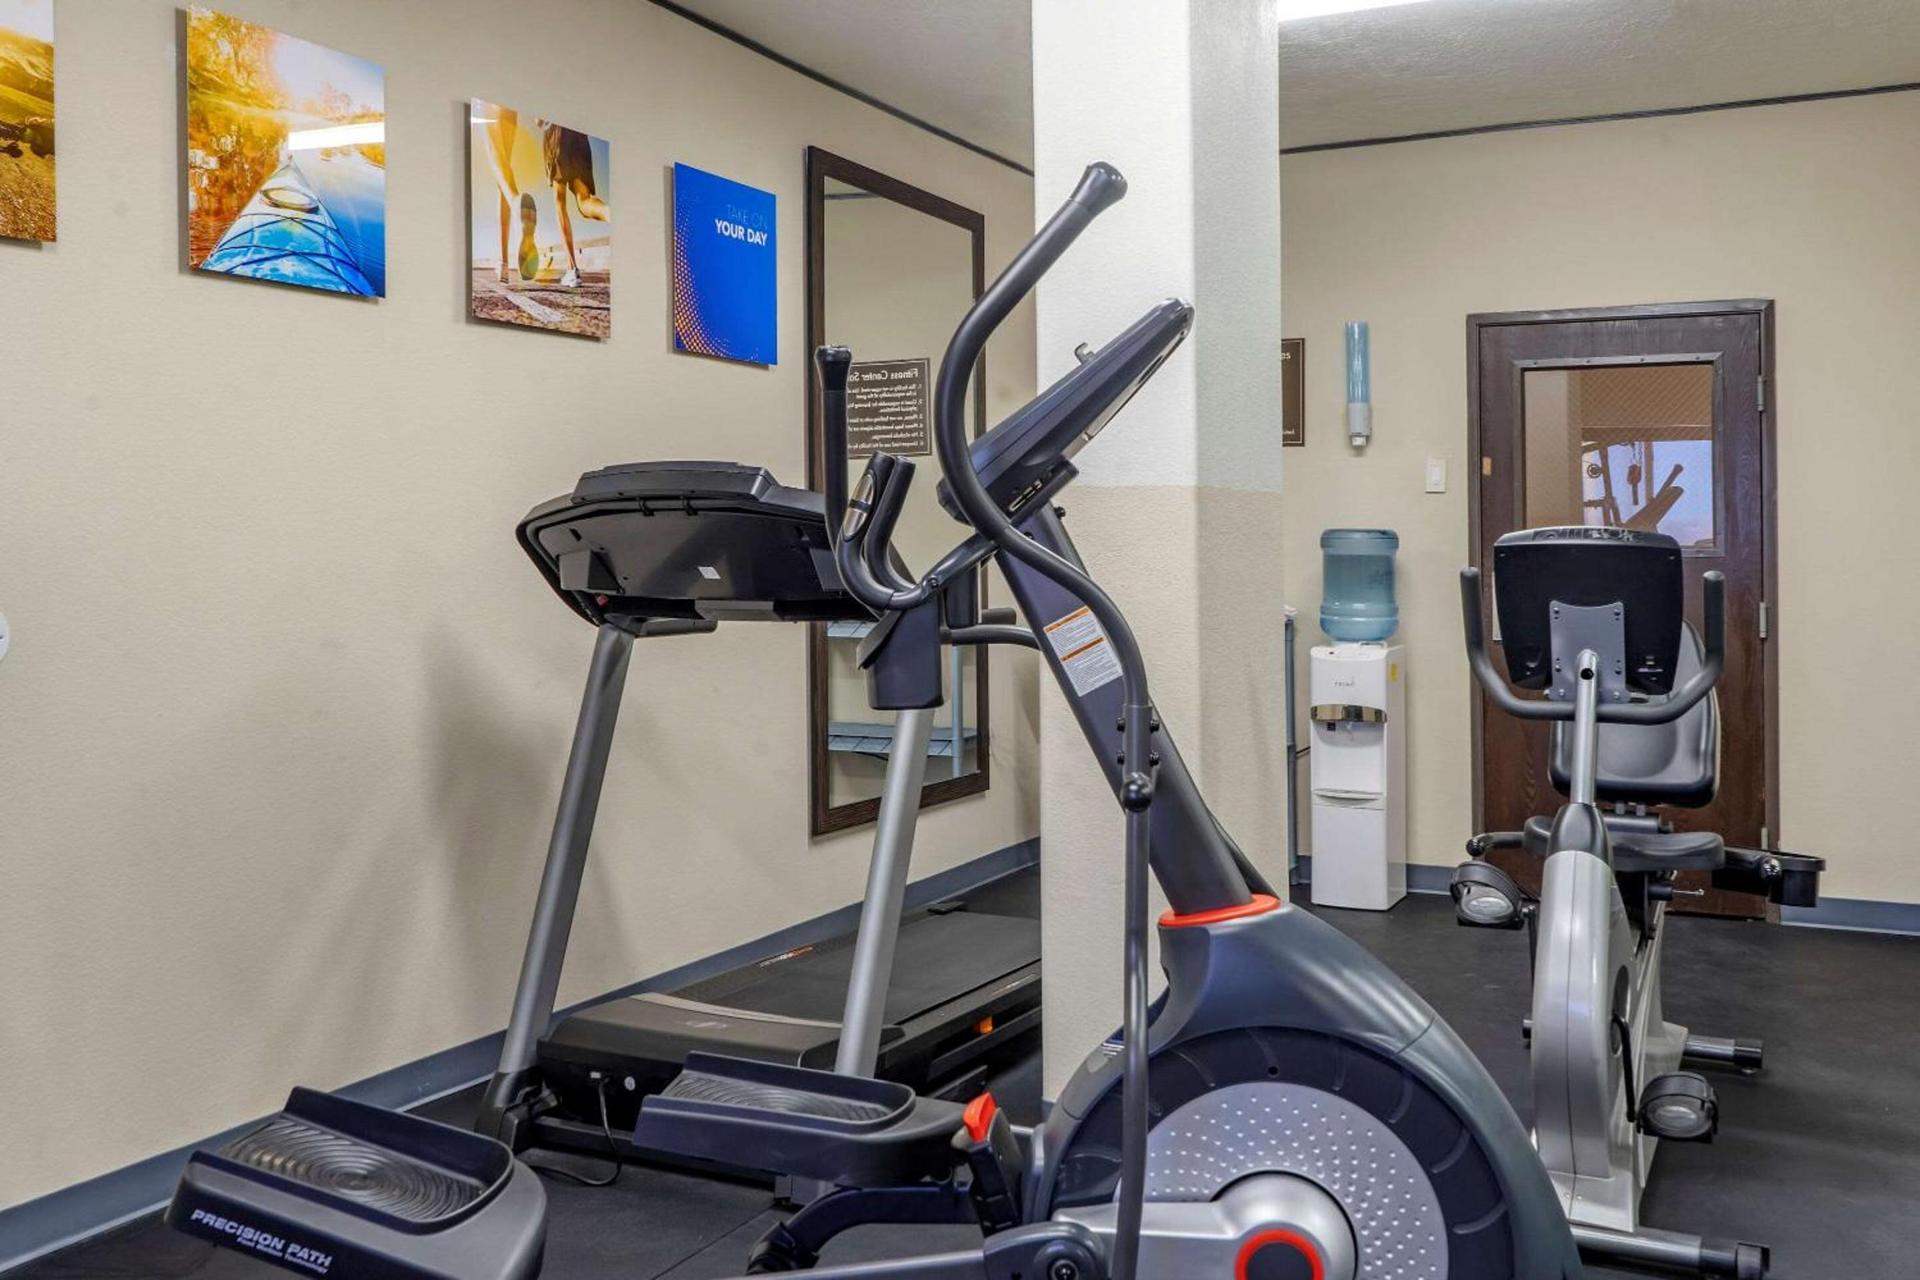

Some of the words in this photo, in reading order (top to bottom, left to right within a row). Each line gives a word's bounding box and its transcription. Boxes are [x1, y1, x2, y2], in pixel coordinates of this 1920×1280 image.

[714, 217, 745, 241] YOUR
[747, 228, 768, 246] DAY
[190, 1208, 286, 1250] PRECISION
[286, 1242, 333, 1267] PATH
